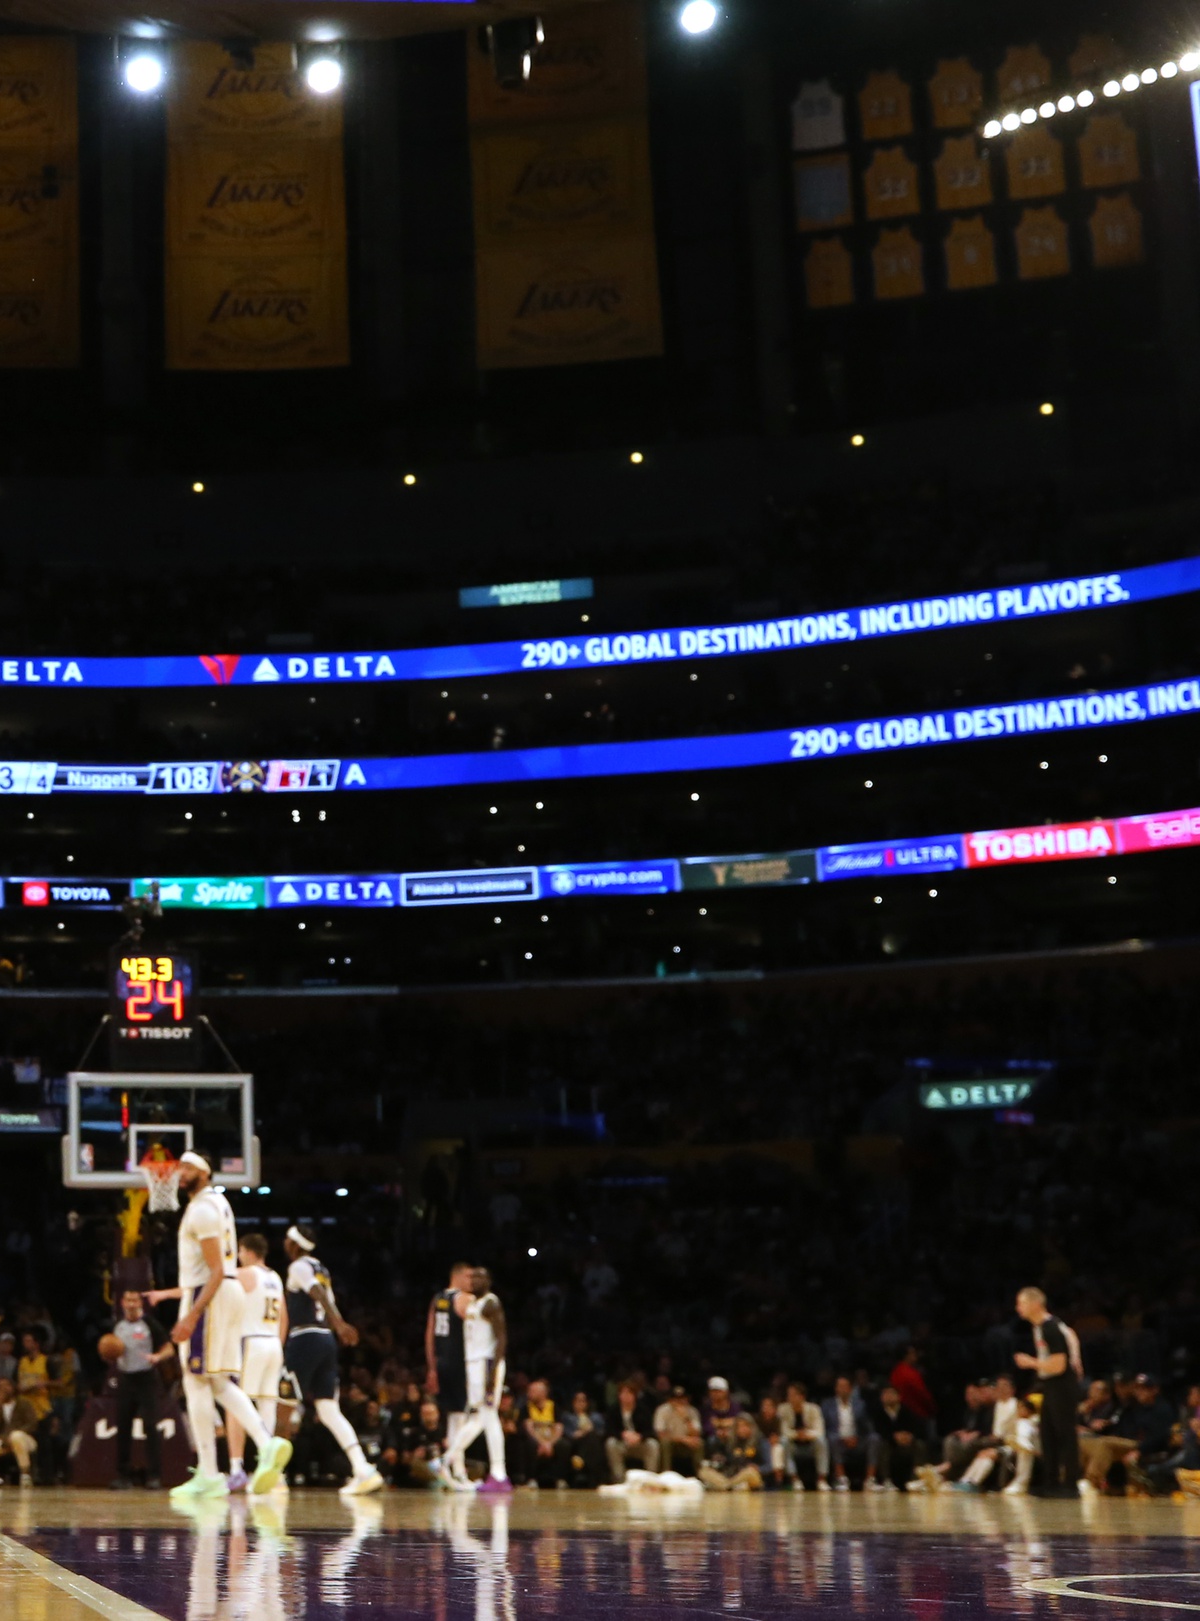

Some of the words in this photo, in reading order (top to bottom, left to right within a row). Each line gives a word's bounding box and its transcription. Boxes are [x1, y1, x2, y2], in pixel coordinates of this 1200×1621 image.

[206, 176, 305, 208] LAKERS
[207, 290, 307, 325] LAKERS
[521, 640, 582, 668] 290+
[584, 631, 676, 664] GLOBAL
[679, 612, 857, 656] DESTINATIONS,
[859, 592, 995, 636] INCLUDING
[996, 574, 1130, 617] PLAYOFFS.
[287, 655, 397, 679] DELTA
[789, 726, 853, 759] 290+
[856, 714, 952, 751] GLOBAL
[954, 690, 1146, 738] DESTINATIONS,
[37, 775, 48, 790] 4
[67, 771, 137, 790] Nuggets
[159, 766, 209, 790] 108
[316, 773, 328, 788] 1
[343, 763, 367, 786] A
[970, 825, 1113, 862] TOSHIBA
[896, 844, 959, 867] ULTRA
[577, 868, 664, 888] crypto.com
[50, 887, 111, 901] TOYOTA
[192, 881, 255, 906] Sprite
[305, 881, 393, 901] DELTA
[121, 957, 173, 982] 43.3
[126, 979, 184, 1021] 24
[139, 1026, 193, 1040] TISSOT
[0, 1113, 41, 1126] TOYOTA
